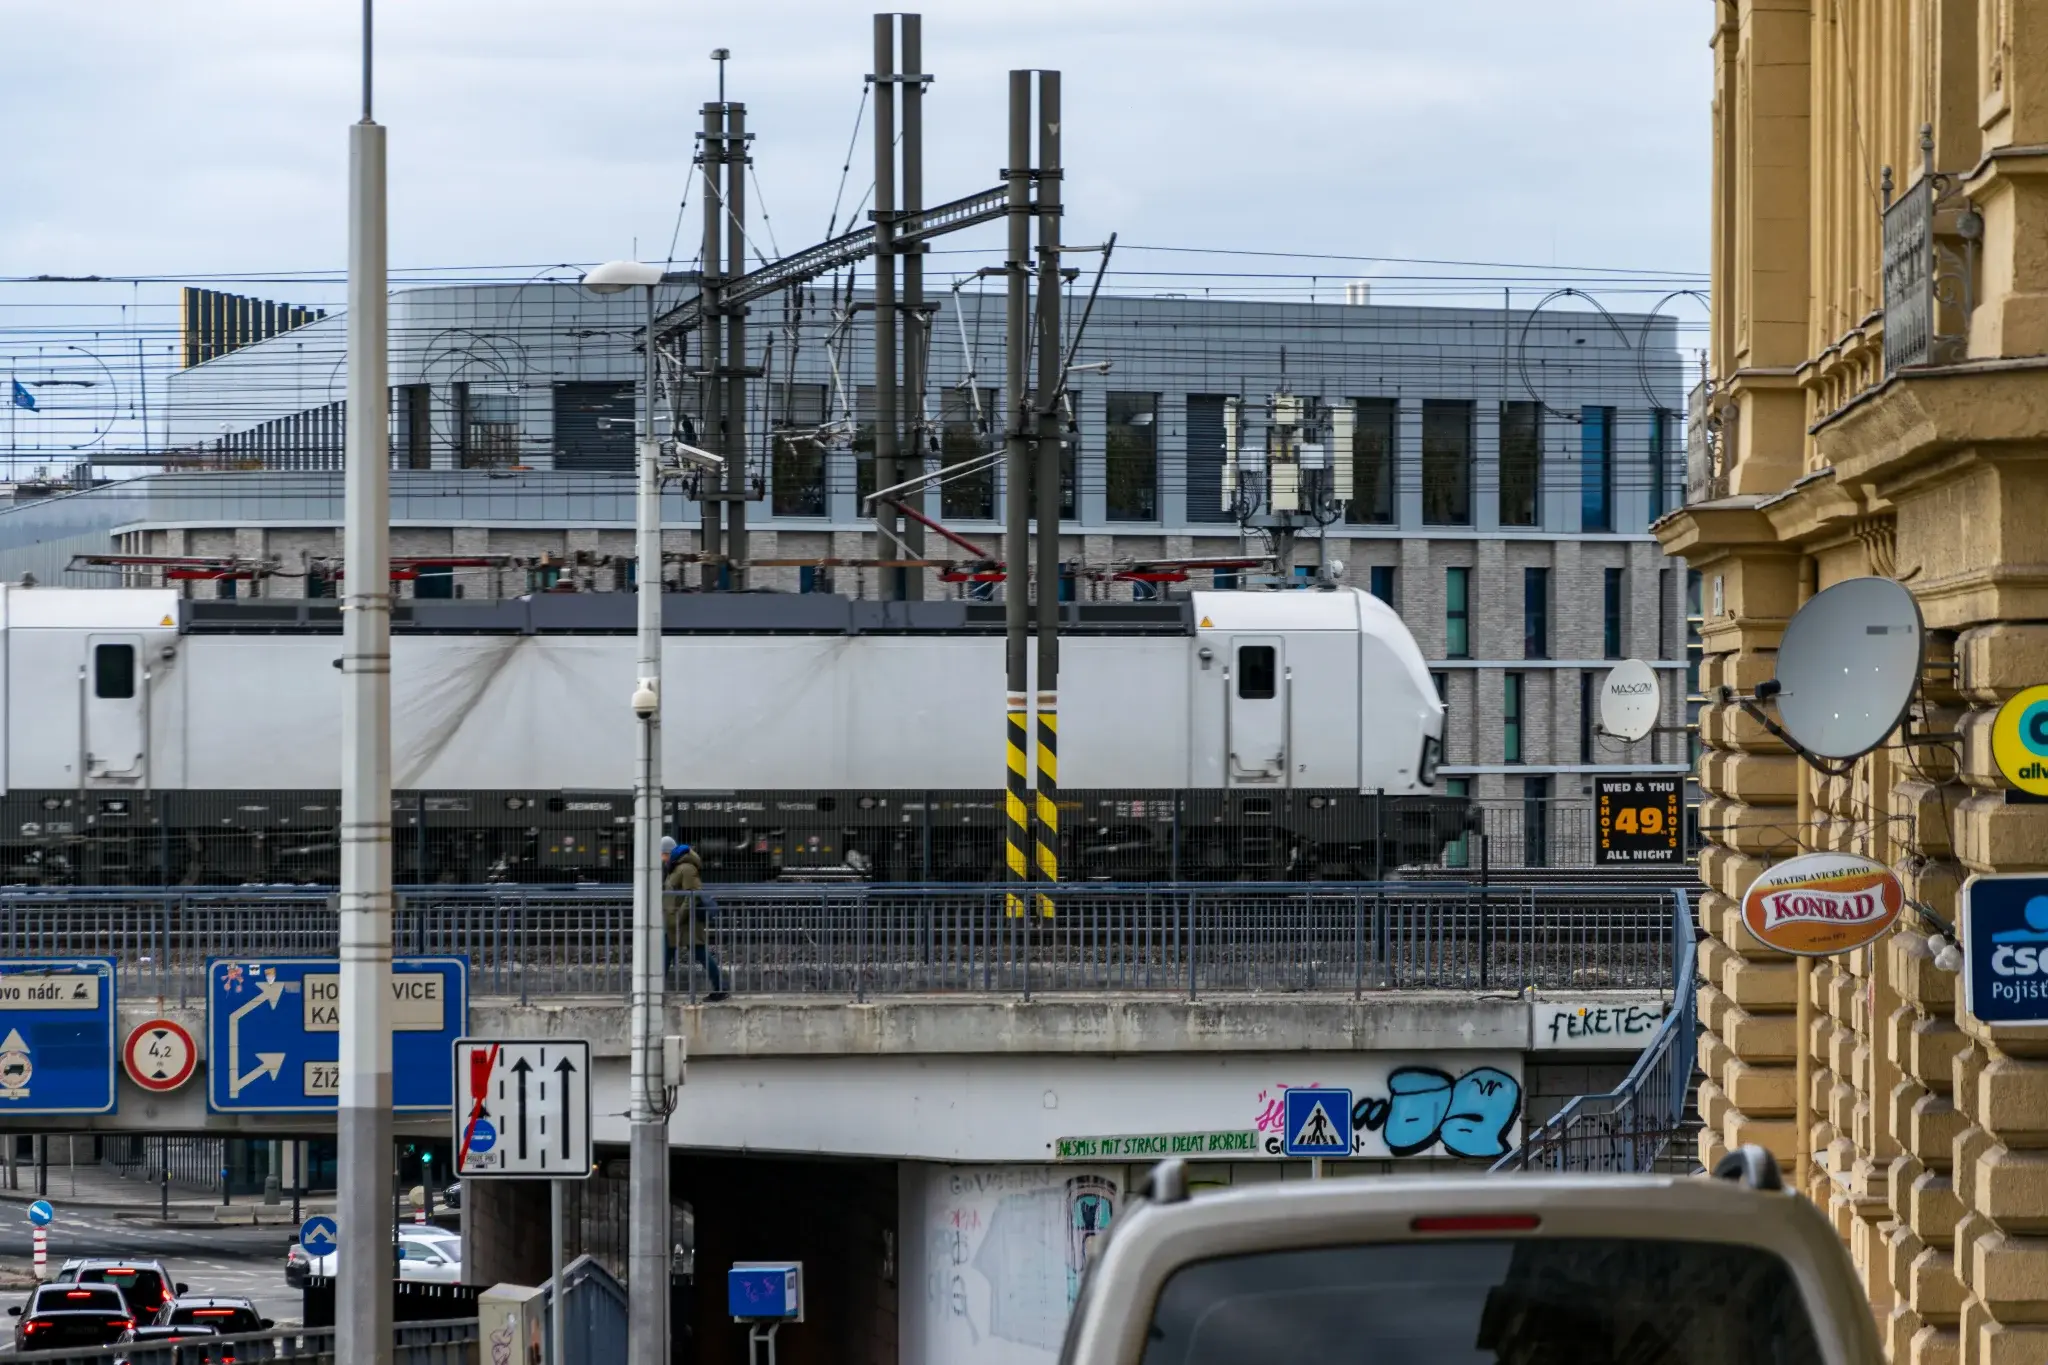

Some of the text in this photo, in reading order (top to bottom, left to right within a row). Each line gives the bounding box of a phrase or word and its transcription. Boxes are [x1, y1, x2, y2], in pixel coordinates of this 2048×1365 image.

[1610, 682, 1653, 694] MASCOM
[1602, 782, 1675, 793] WED & THU
[1600, 795, 1610, 849] SHOTS
[1615, 807, 1663, 835] 49
[1667, 794, 1678, 848] SHOTS
[1606, 850, 1673, 860] ALL NIGHT
[1769, 866, 1870, 887] VRATISLAVICKÉ PIVO
[1772, 892, 1875, 921] KONRAD
[27, 983, 64, 1000] nádr.
[149, 1041, 172, 1059] 4,2
[1123, 1136, 1168, 1155] STRACH
[1208, 1132, 1257, 1151] BORDEL
